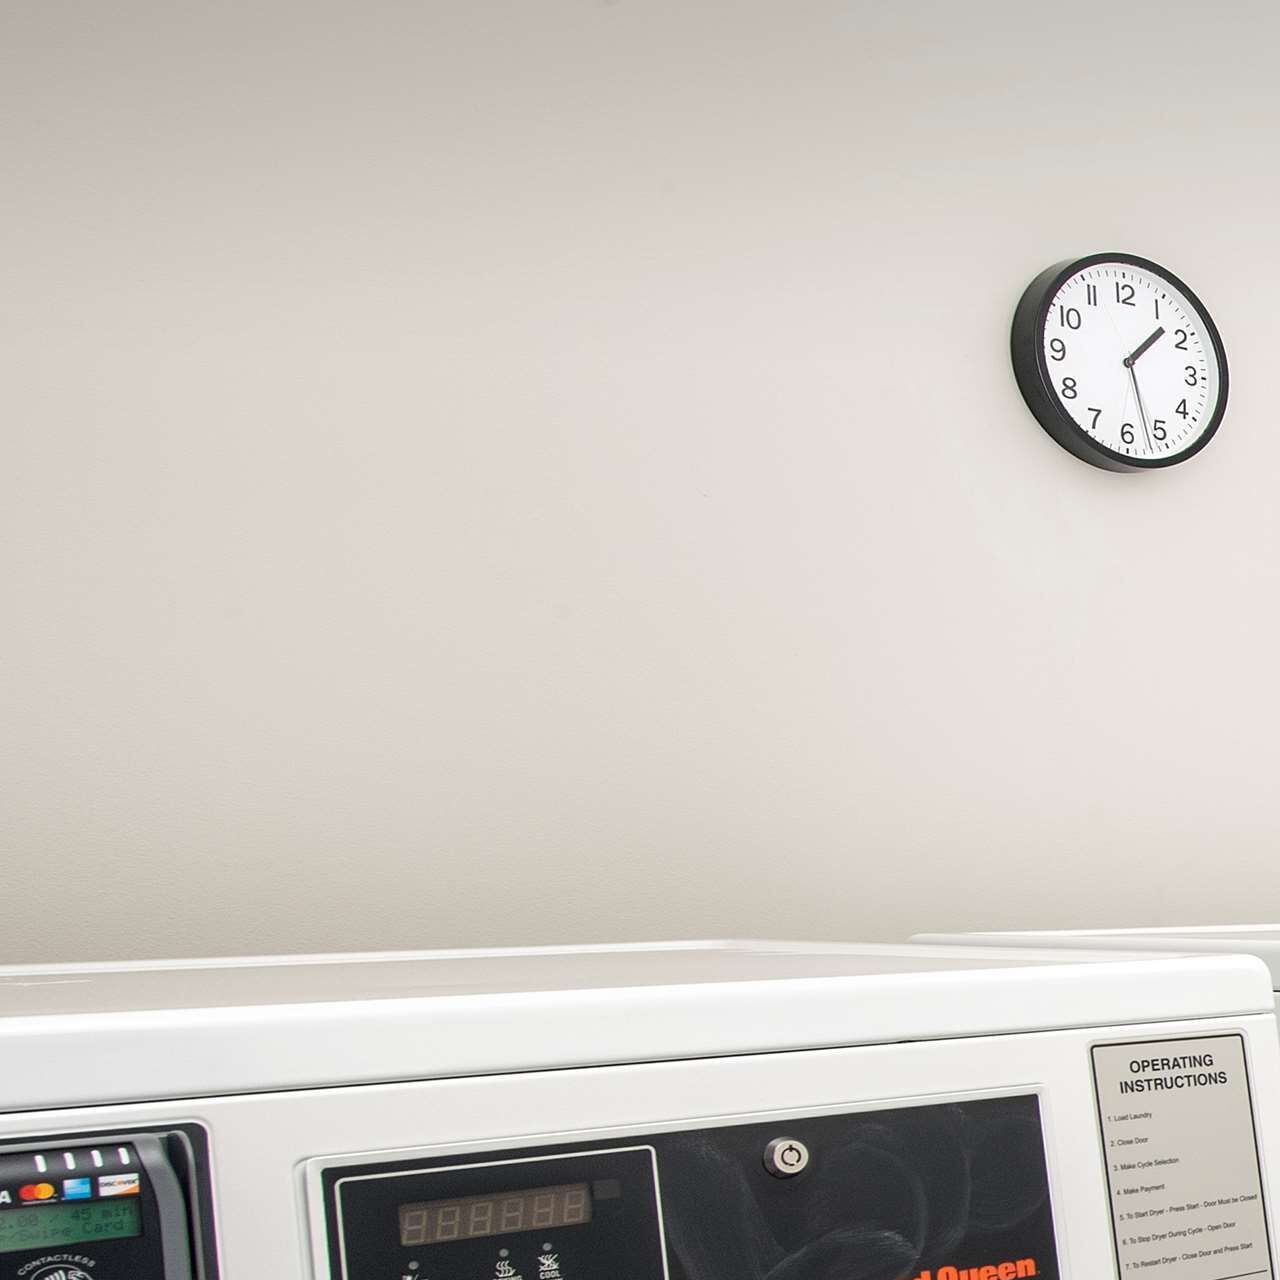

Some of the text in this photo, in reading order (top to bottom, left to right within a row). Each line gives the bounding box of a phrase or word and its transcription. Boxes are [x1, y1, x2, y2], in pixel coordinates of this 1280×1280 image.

[1087, 284, 1097, 306] 11
[1116, 282, 1136, 306] 12
[1060, 305, 1082, 329] 10
[1050, 338, 1066, 361] 9
[1174, 329, 1188, 350] 2
[1184, 366, 1197, 386] 3
[1061, 377, 1077, 399] 8
[1087, 407, 1102, 429] 7
[1175, 399, 1189, 419] 4
[1120, 423, 1135, 444] 6
[1153, 420, 1167, 440] 5
[1129, 1054, 1214, 1073] OPERATING
[1120, 1072, 1227, 1094] INSTRUCTIONS
[1129, 1112, 1152, 1121] Laundry
[1137, 1161, 1153, 1169] Cycle
[82, 1219, 125, 1234] Card
[17, 1254, 96, 1276] CONTACTLESS
[1162, 1256, 1177, 1264] Dryer
[539, 1271, 561, 1280] COOL
